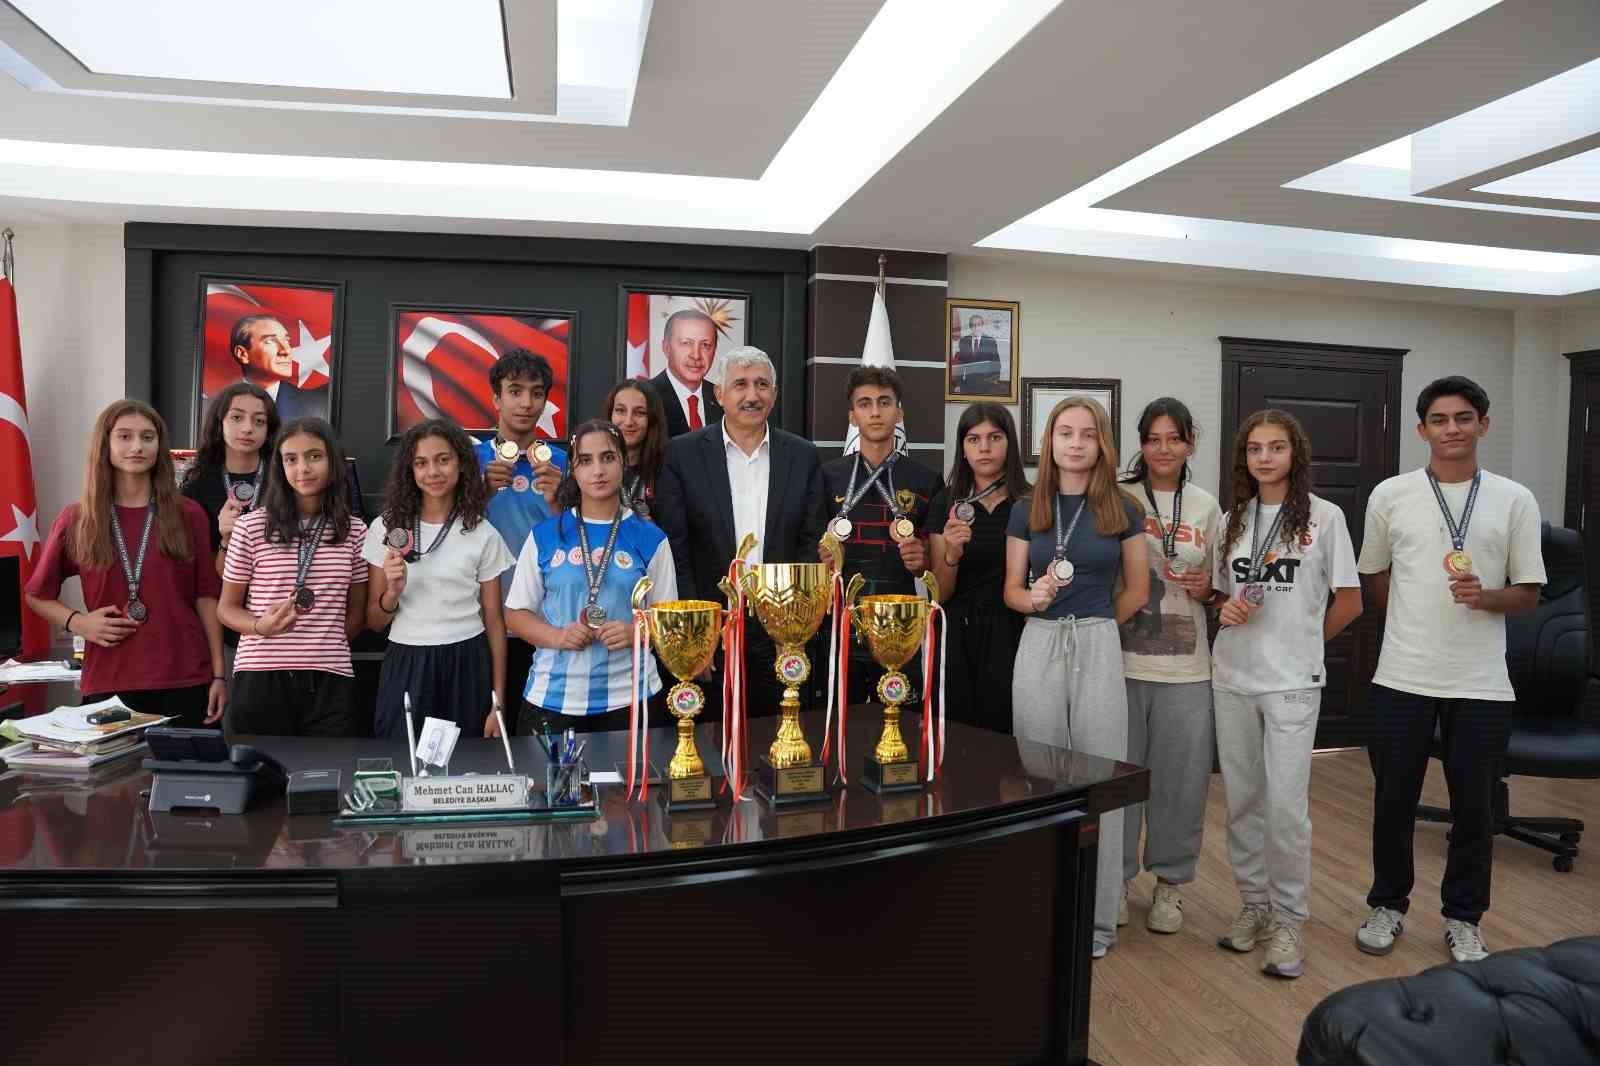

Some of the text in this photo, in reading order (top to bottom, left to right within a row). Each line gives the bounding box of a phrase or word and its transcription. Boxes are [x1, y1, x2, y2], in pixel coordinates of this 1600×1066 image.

[1275, 585, 1294, 593] car
[414, 783, 515, 796] Mehmet Can HALLAÇ
[466, 796, 497, 805] BAŞKANI
